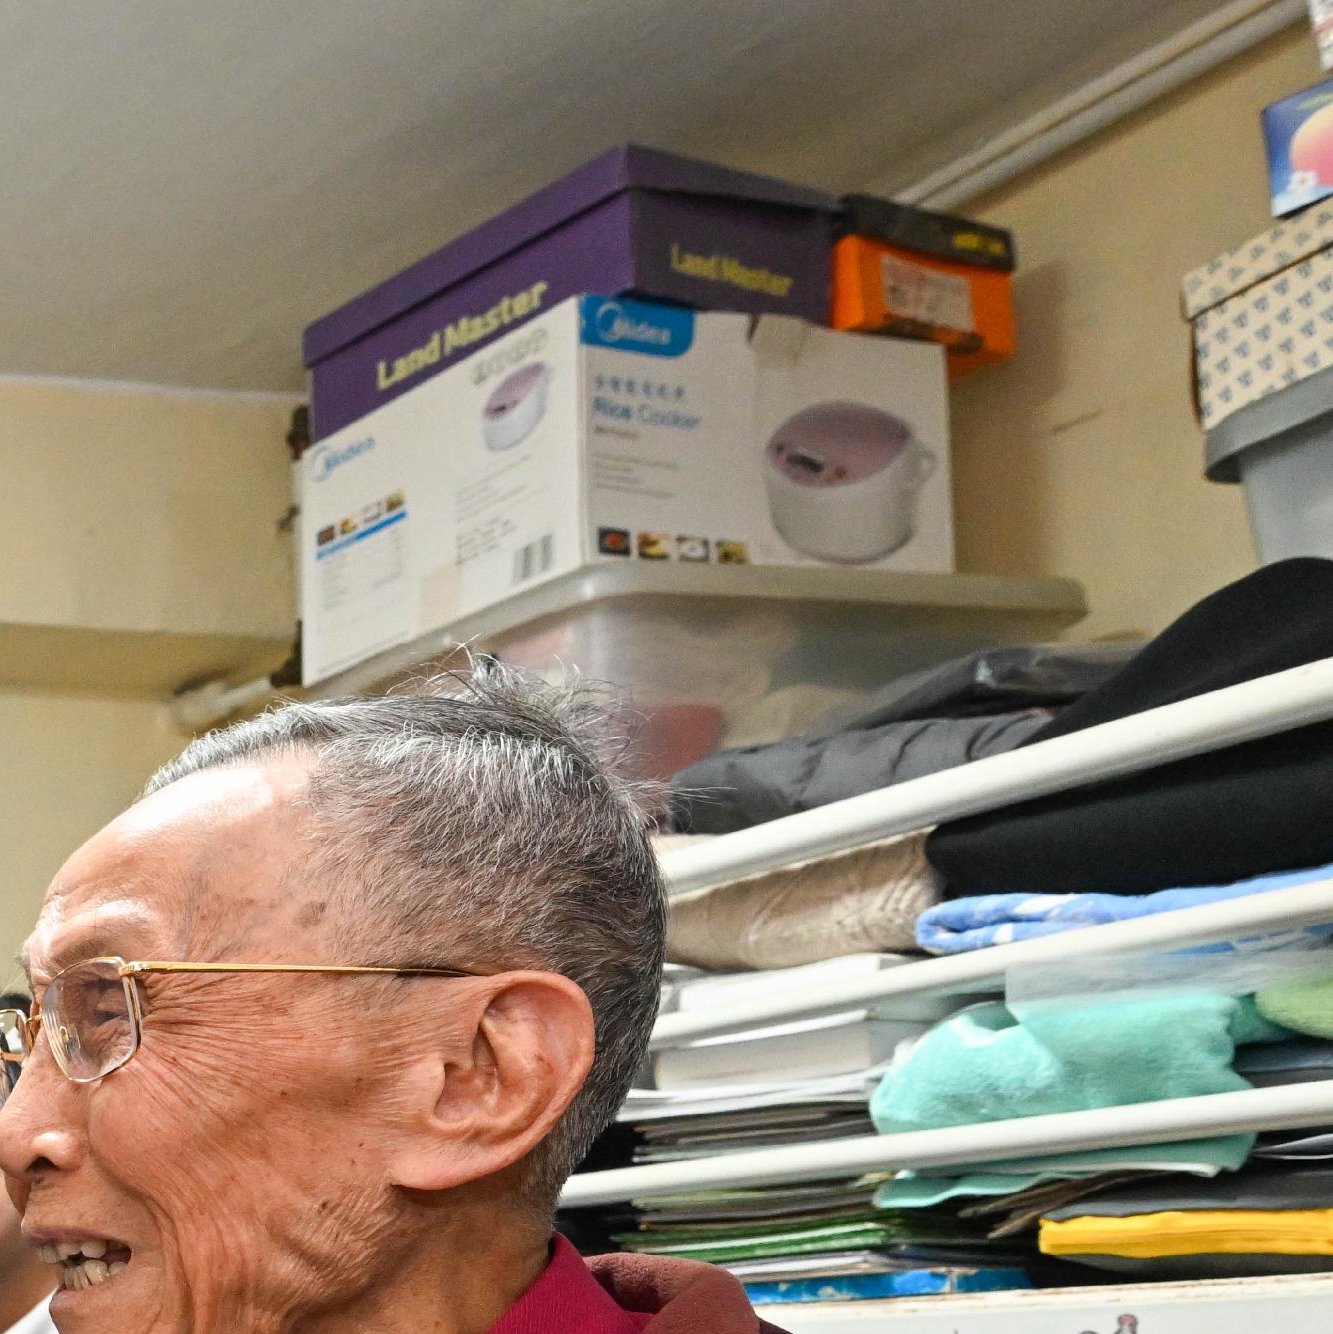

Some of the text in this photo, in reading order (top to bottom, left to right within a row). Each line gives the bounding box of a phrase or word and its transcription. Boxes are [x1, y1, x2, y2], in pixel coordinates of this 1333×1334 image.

[670, 243, 719, 280] Land
[377, 332, 442, 390] Land
[443, 280, 549, 356] Master
[593, 397, 702, 430] Rice Cooker
